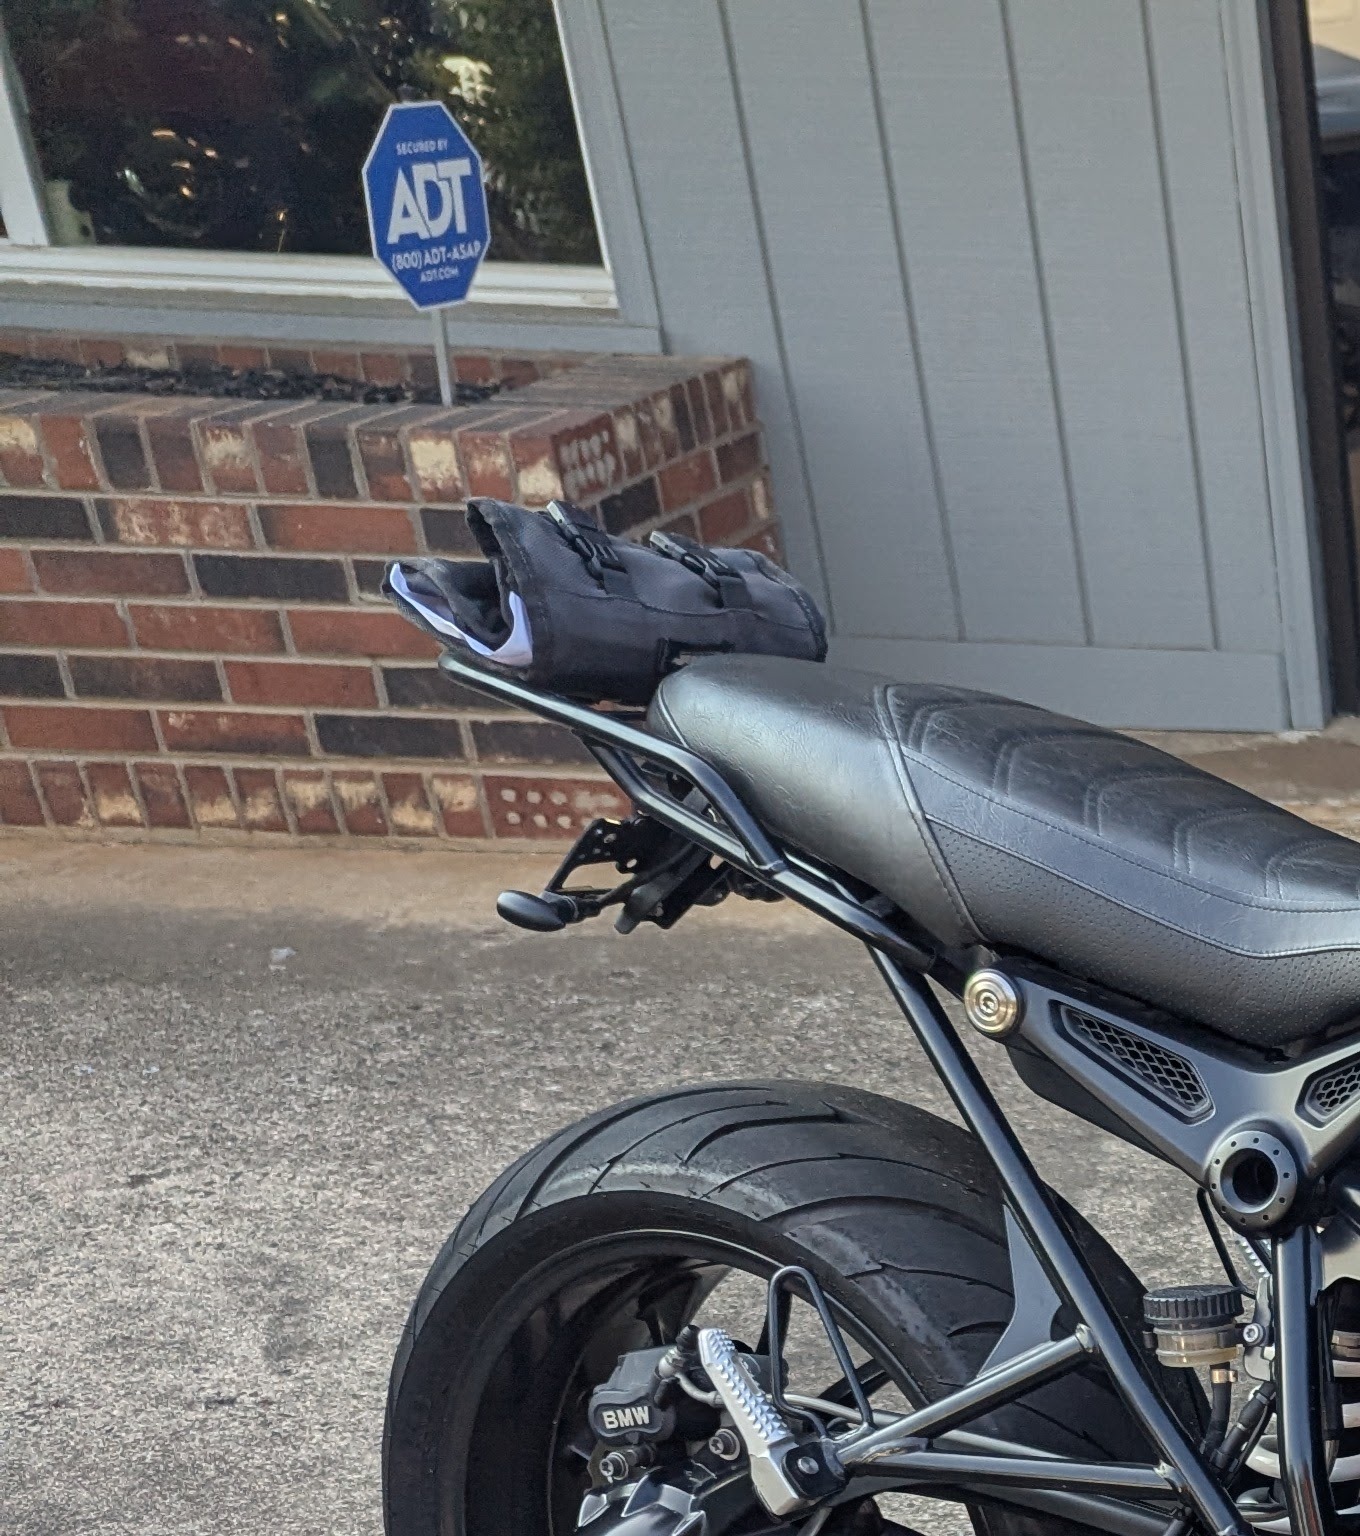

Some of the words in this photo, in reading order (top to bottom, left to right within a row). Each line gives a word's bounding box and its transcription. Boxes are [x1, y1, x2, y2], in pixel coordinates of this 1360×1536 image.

[386, 157, 472, 245] ADT
[392, 248, 423, 274] (800)
[424, 240, 482, 267] ADT-ASAP
[602, 1405, 650, 1430] BMW
